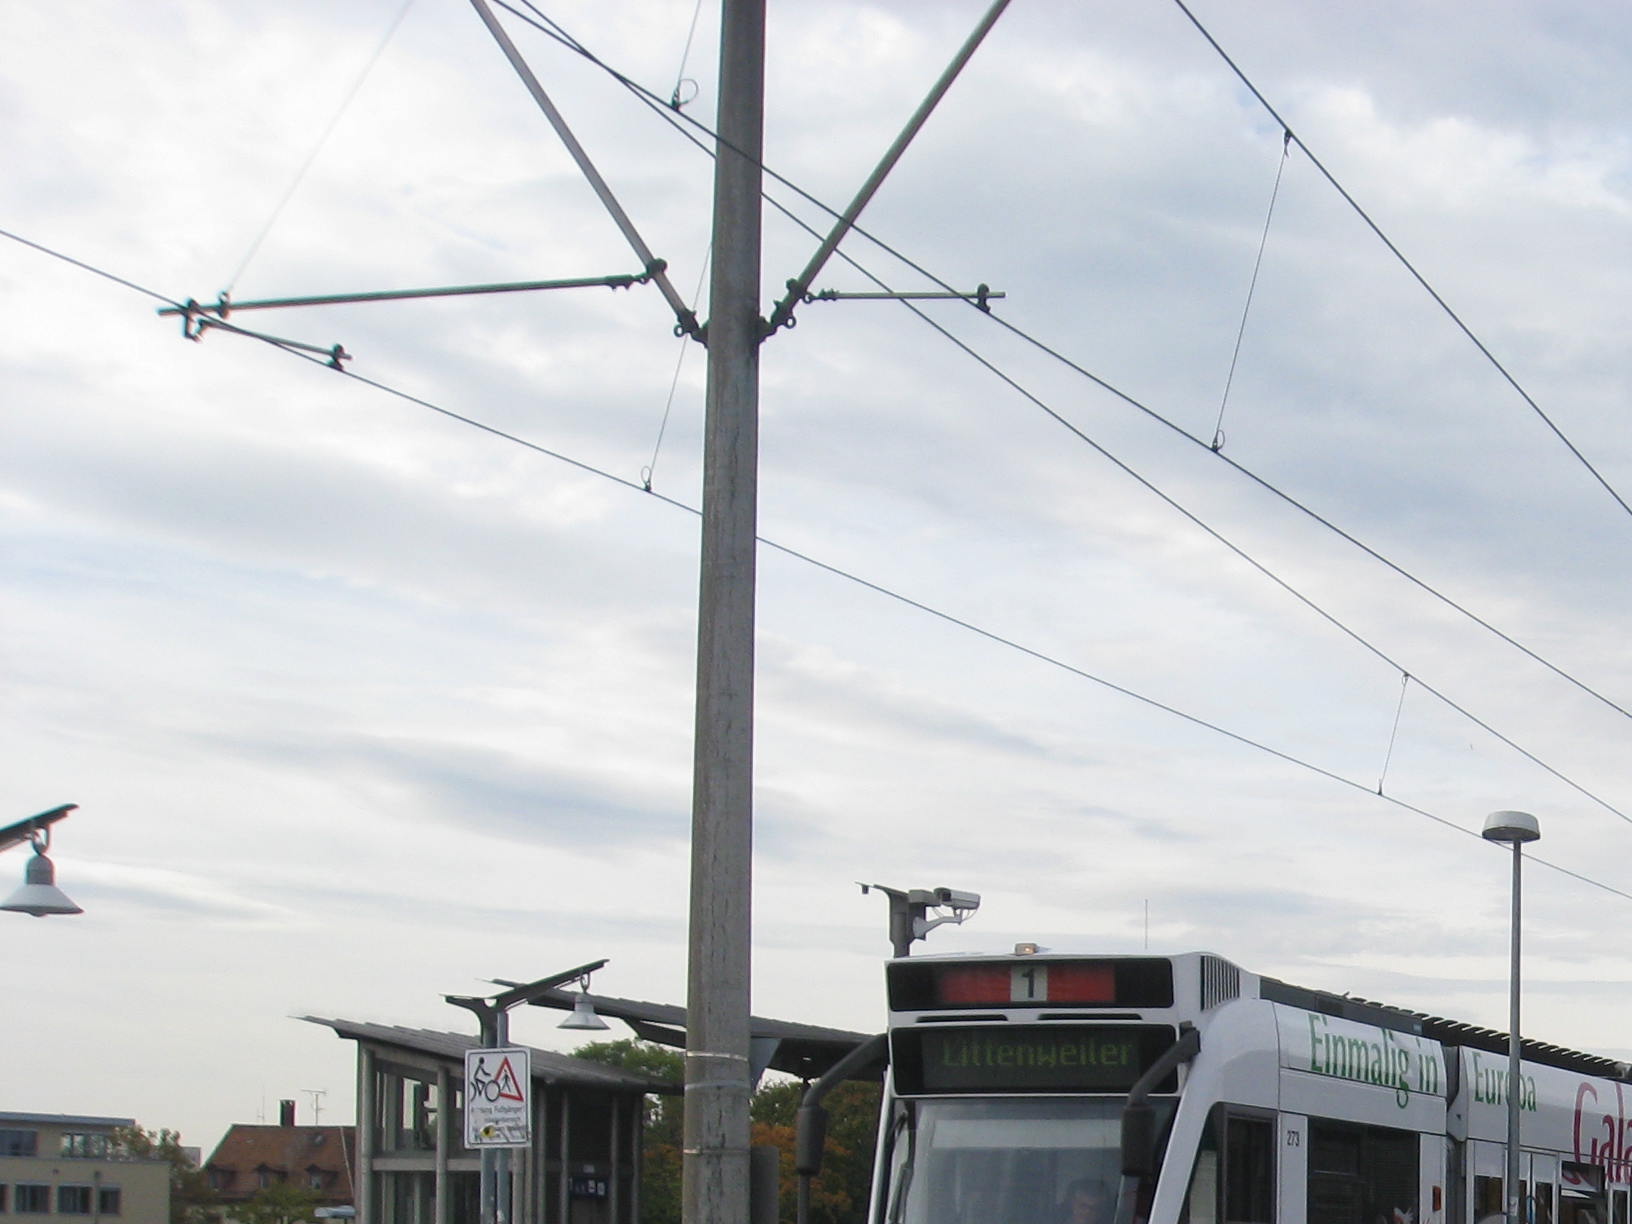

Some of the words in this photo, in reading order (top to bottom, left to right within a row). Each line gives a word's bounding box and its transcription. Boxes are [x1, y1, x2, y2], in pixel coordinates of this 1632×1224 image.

[1021, 968, 1035, 998] 1
[943, 1036, 1133, 1066] Littenweiler
[1307, 1013, 1410, 1109] Einmalig
[1416, 1037, 1440, 1094] in
[1287, 1130, 1300, 1147] 273
